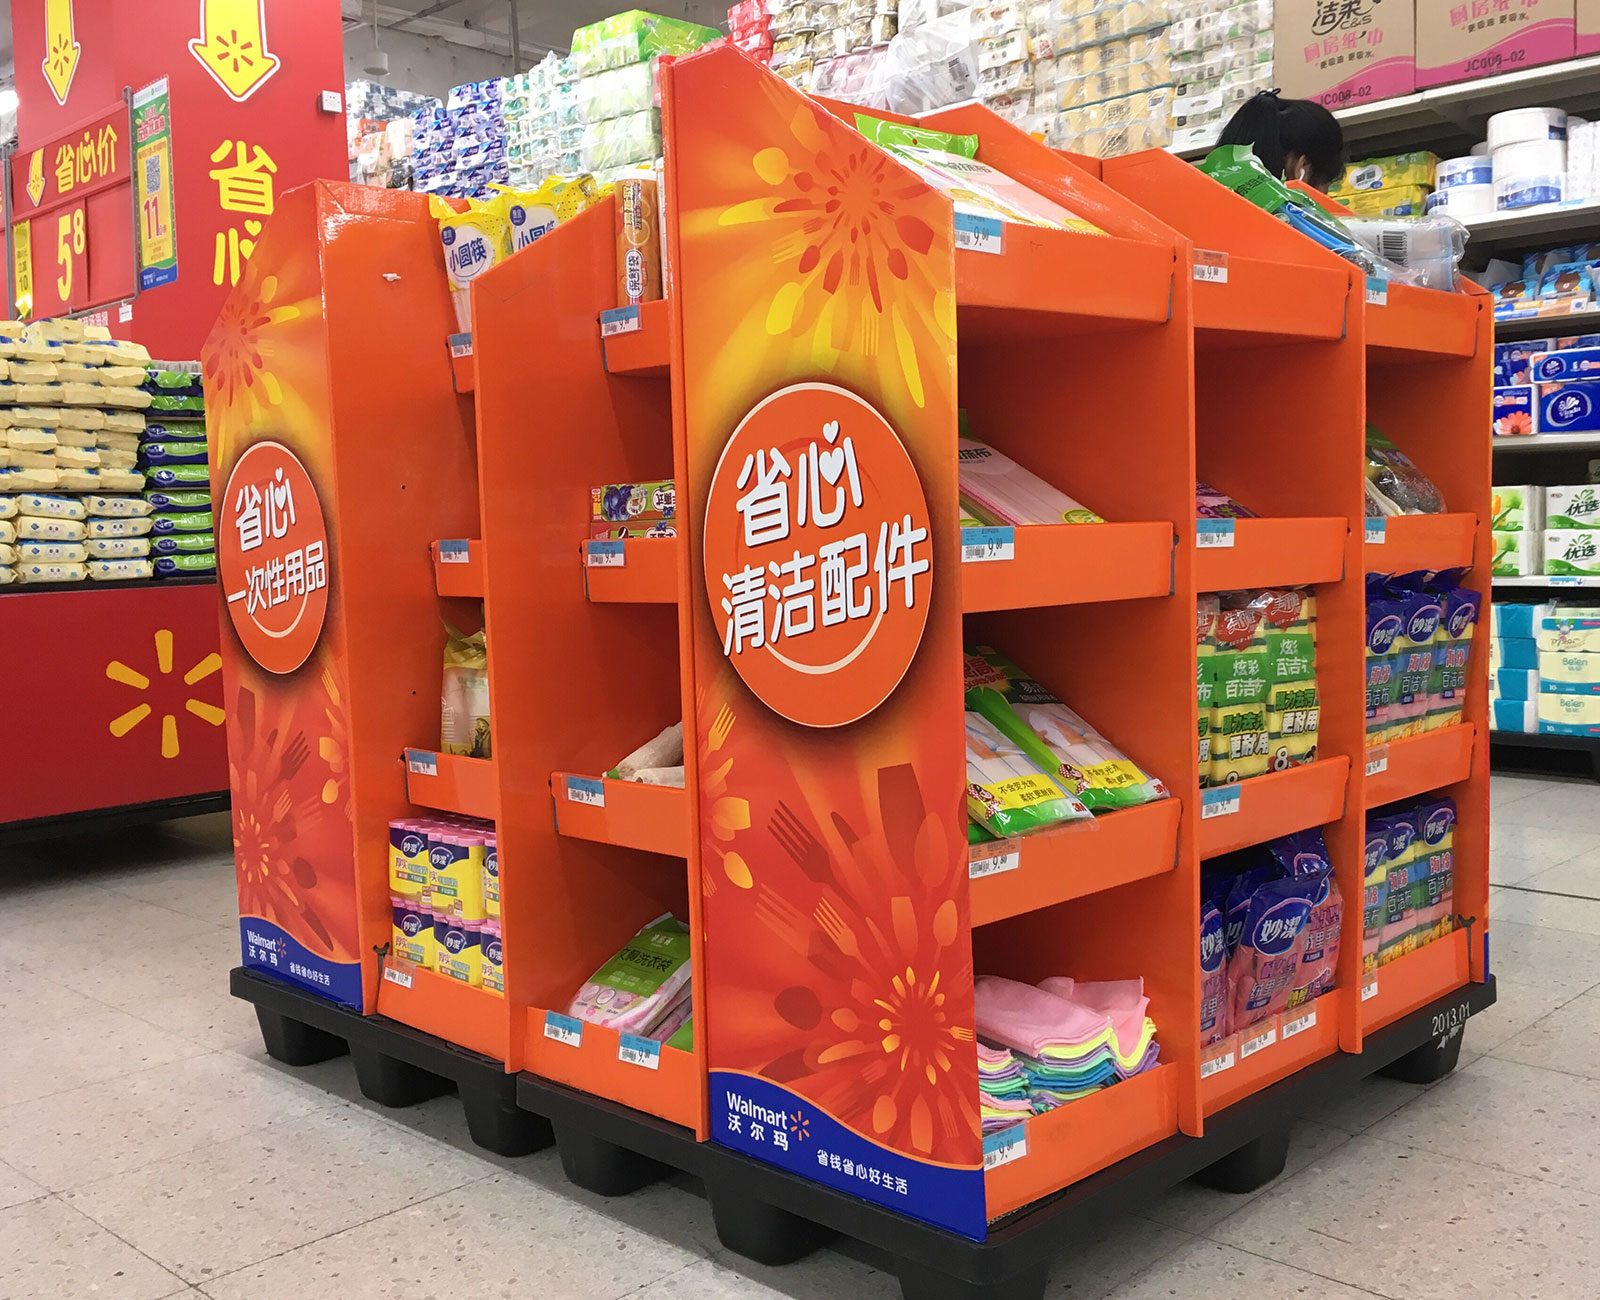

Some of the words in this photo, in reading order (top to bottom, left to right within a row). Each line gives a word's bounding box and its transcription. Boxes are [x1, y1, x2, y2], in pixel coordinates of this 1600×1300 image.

[55, 124, 118, 194] 省心价
[518, 220, 556, 250] 小圆
[449, 237, 487, 272] 小圆筷
[736, 419, 863, 547] 省心
[236, 467, 297, 552] 省心
[1565, 499, 1600, 516] 优选
[988, 538, 1003, 556] 9.80
[1562, 543, 1598, 561] 优选
[227, 540, 326, 615] 一次性用品
[721, 514, 930, 657] 清洁配件
[1232, 659, 1261, 677] 炫彩
[1225, 677, 1267, 699] 百洁布
[1282, 709, 1319, 735] 更耐用
[1230, 732, 1269, 760] 更耐用
[1019, 788, 1057, 802] 柔软更耐用
[992, 854, 1008, 871] 9.80
[247, 929, 277, 952] Walmart
[248, 945, 278, 967] 沃尔玛
[1432, 1001, 1470, 1036] 2013.01
[726, 1090, 788, 1130] Walmart
[727, 1113, 789, 1152] 沃尔玛
[999, 1138, 1015, 1161] 9.80
[816, 1149, 908, 1196] 省钱省心好生活
